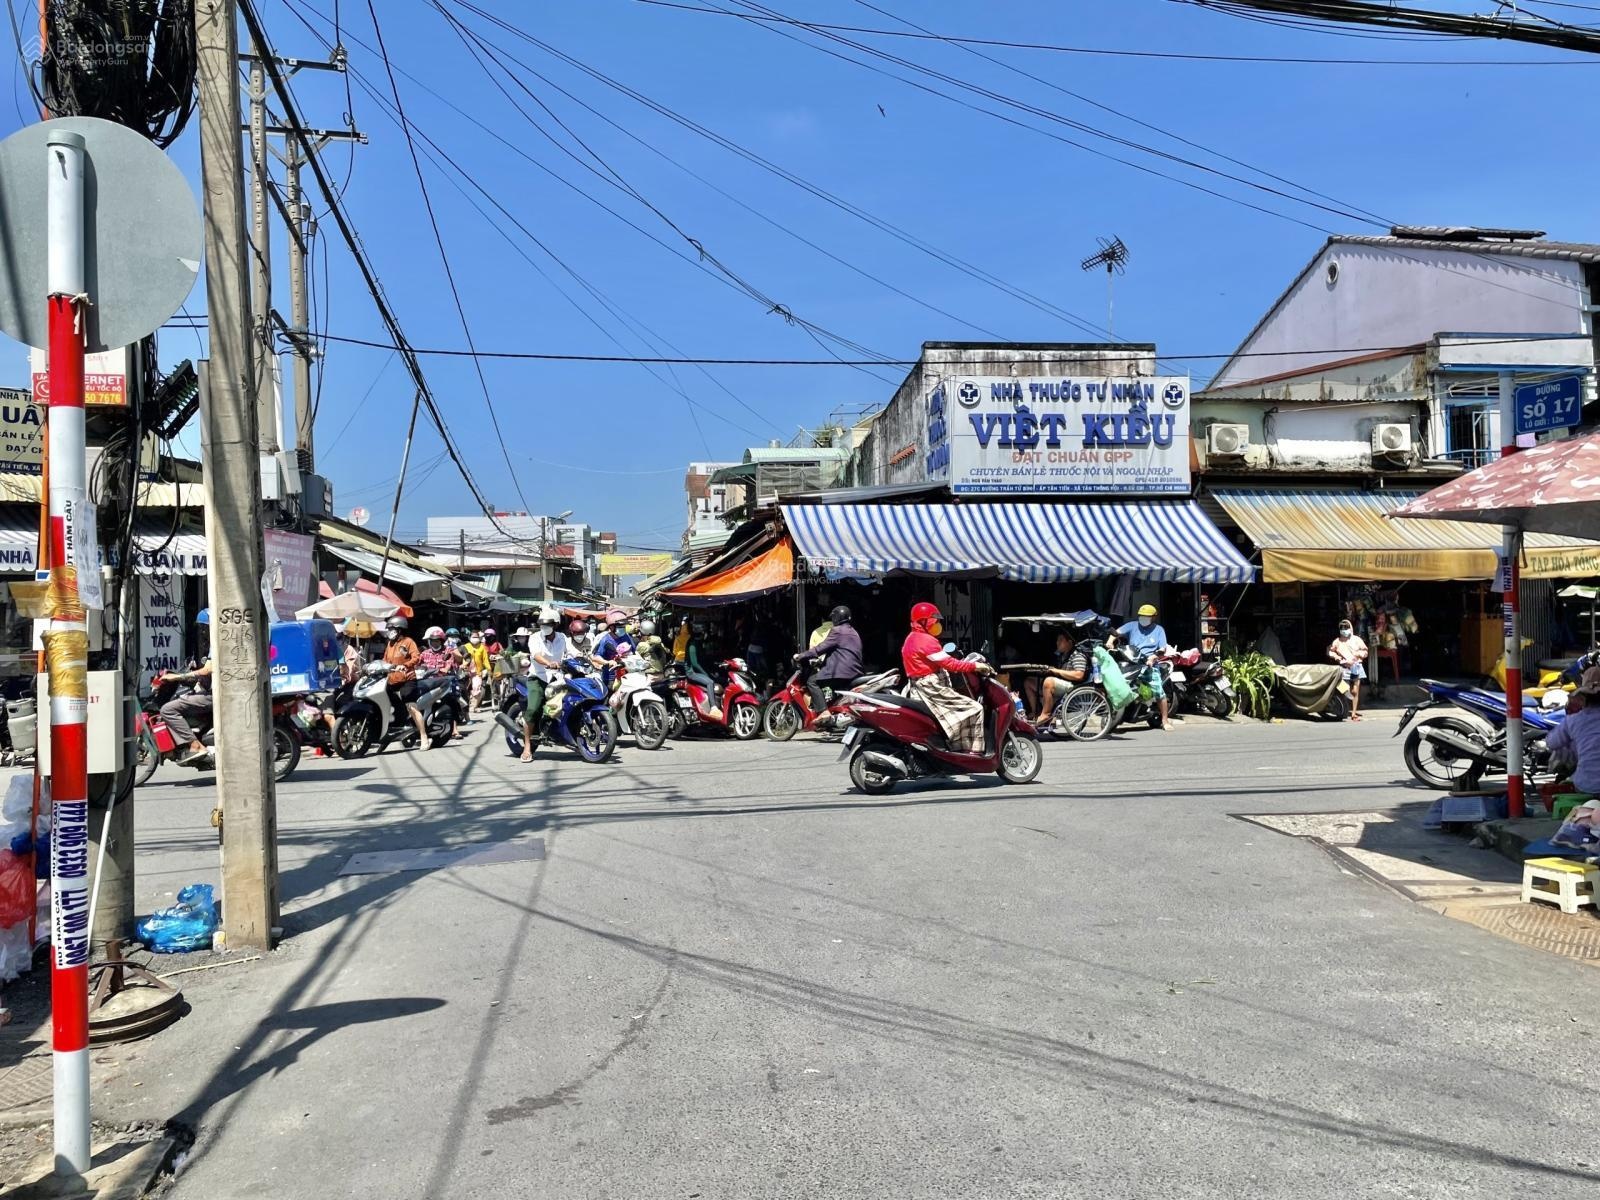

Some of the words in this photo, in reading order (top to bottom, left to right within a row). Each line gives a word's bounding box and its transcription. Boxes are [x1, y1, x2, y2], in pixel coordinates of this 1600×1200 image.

[85, 374, 122, 385] ERNET
[991, 380, 1023, 402] NHÀ
[1029, 379, 1081, 403] THUỐC
[1086, 380, 1107, 402] TƯ
[1112, 379, 1155, 402] NHÂN
[2, 404, 40, 426] UÂ
[1523, 396, 1547, 419] SỐ
[1554, 397, 1575, 414] 17
[968, 405, 1067, 455] VIỆT
[1081, 399, 1176, 450] KIỀU
[5, 444, 27, 455] ĐẠT
[1012, 451, 1042, 465] ĐẠT
[1104, 451, 1133, 463] GPP
[970, 466, 1010, 476] CHUYÊN
[0, 547, 33, 564] NHÀ
[144, 614, 179, 628] THUỐC
[151, 634, 171, 648] TÂY
[145, 656, 177, 672] XUÂN
[59, 801, 87, 823] 444
[58, 825, 87, 848] 909
[57, 848, 87, 879] 0933
[60, 887, 88, 911] 177
[62, 909, 88, 934] 100
[65, 935, 88, 965] 0967
